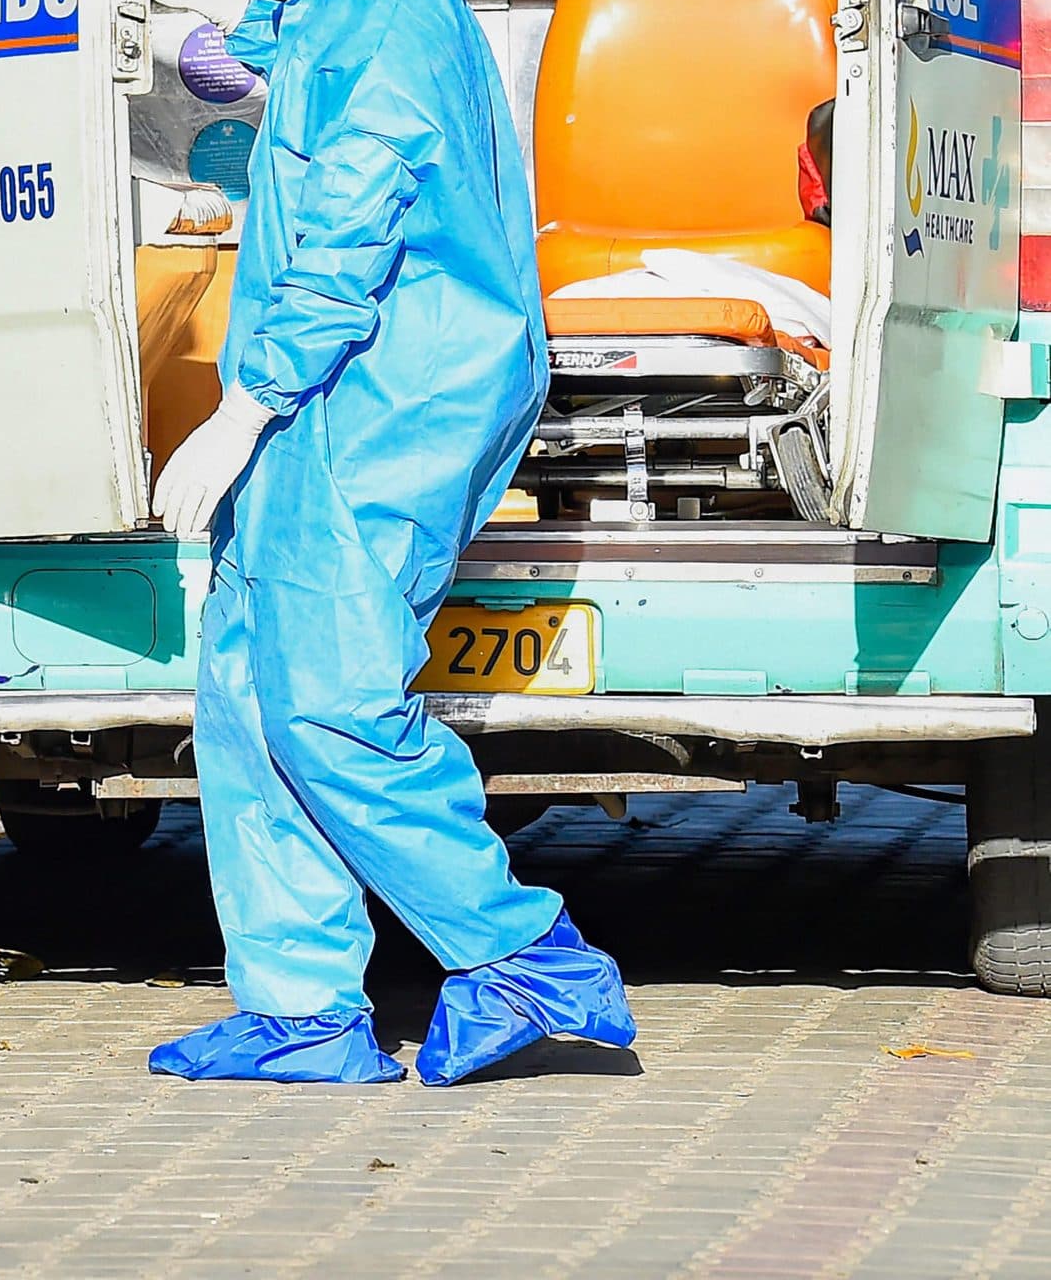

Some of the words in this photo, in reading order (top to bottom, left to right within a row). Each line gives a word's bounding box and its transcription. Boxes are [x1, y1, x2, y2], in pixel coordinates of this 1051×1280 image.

[926, 127, 976, 203] MAX
[925, 212, 975, 244] HEALTHCARE
[448, 626, 573, 677] 2704
